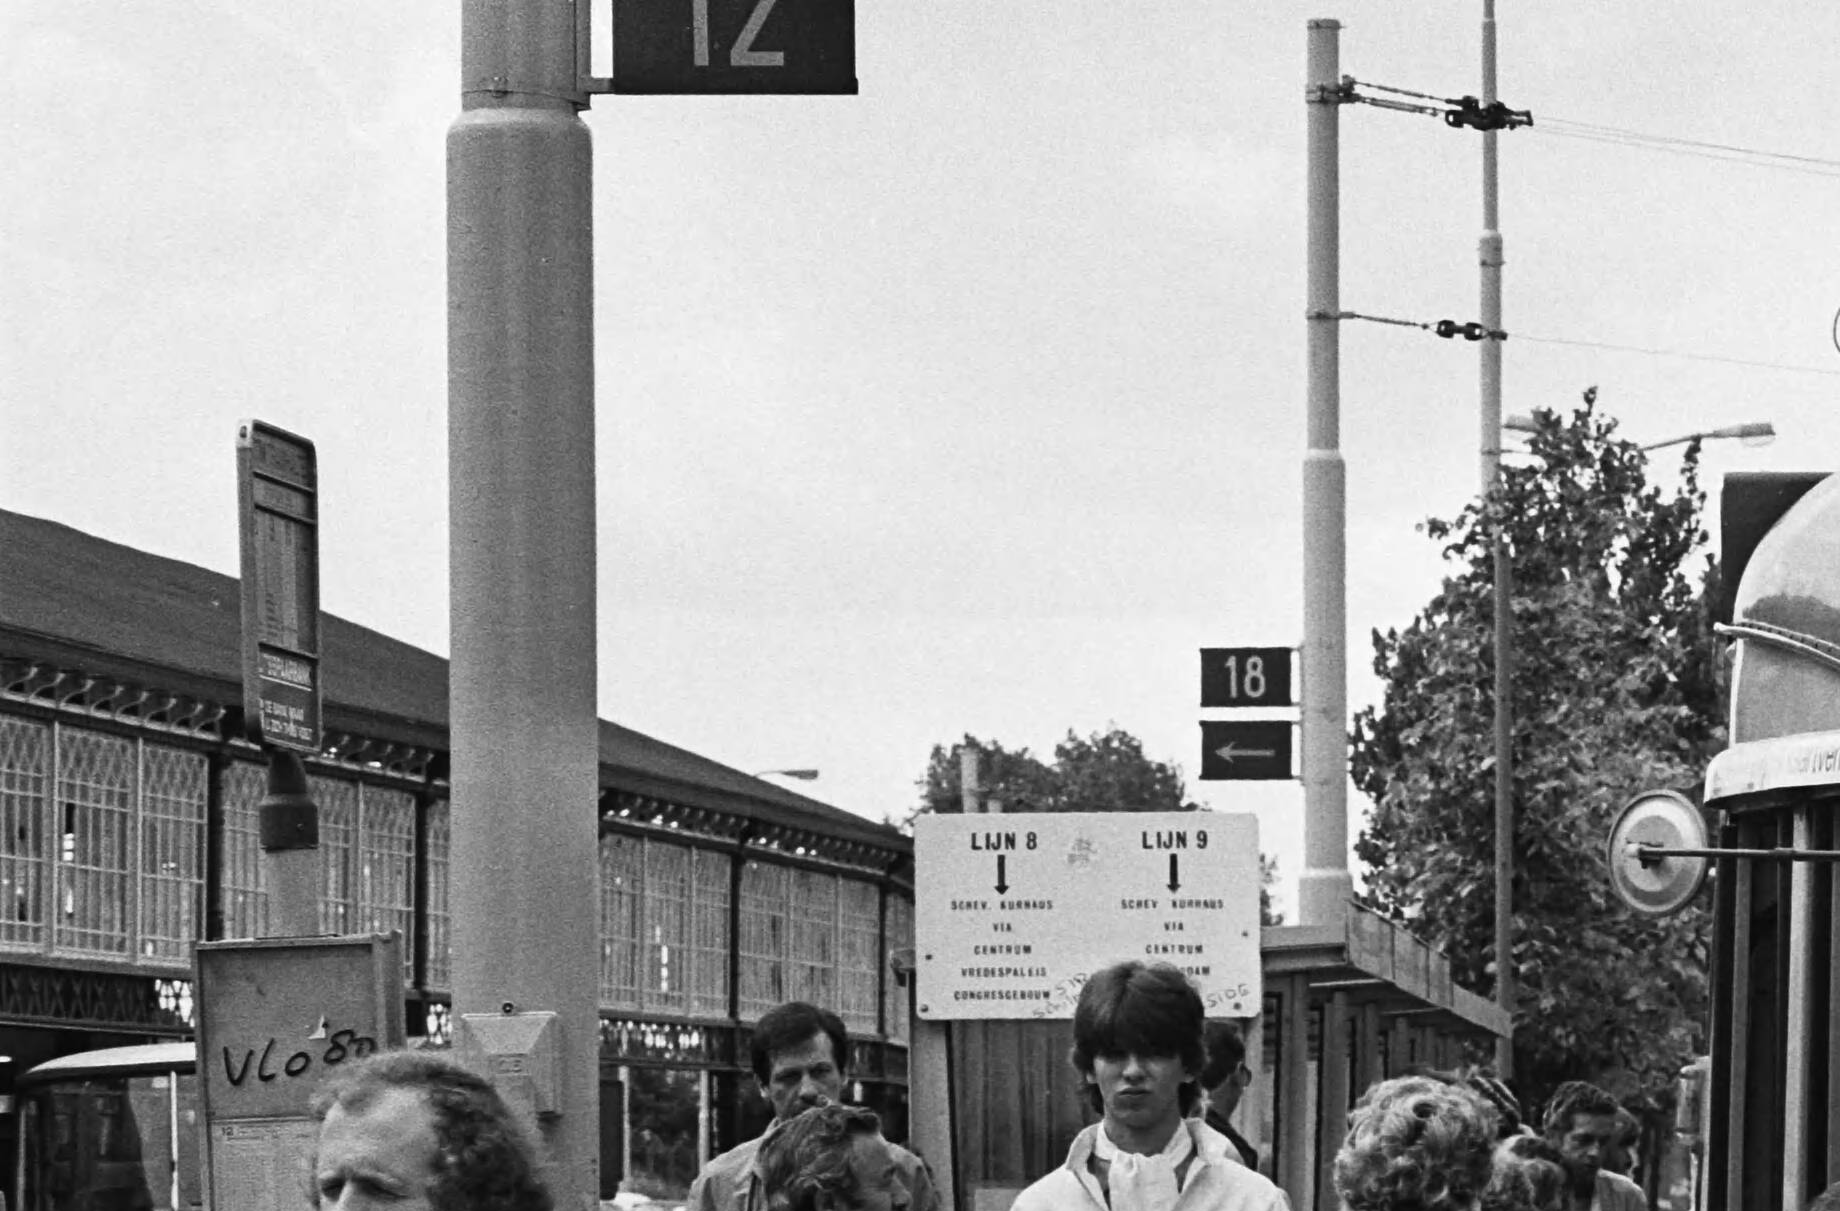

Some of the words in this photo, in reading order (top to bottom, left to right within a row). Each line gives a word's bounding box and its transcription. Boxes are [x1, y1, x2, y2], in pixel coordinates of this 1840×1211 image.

[1226, 655, 1266, 698] 18
[971, 832, 1016, 850] LIJN
[1025, 831, 1038, 850] 8
[1142, 831, 1188, 850] LIJN
[1196, 829, 1208, 850] 9
[1000, 900, 1053, 911] KURHAUS
[1172, 899, 1224, 910] KURHAUS
[993, 923, 1013, 932] VIA
[1164, 921, 1184, 931] VIA
[974, 945, 1032, 956] CENTRUM
[1146, 944, 1204, 955] CENTRUM
[961, 967, 1047, 978] VREDESPALEIS
[953, 990, 1051, 1002] CONGRESGEBOUW
